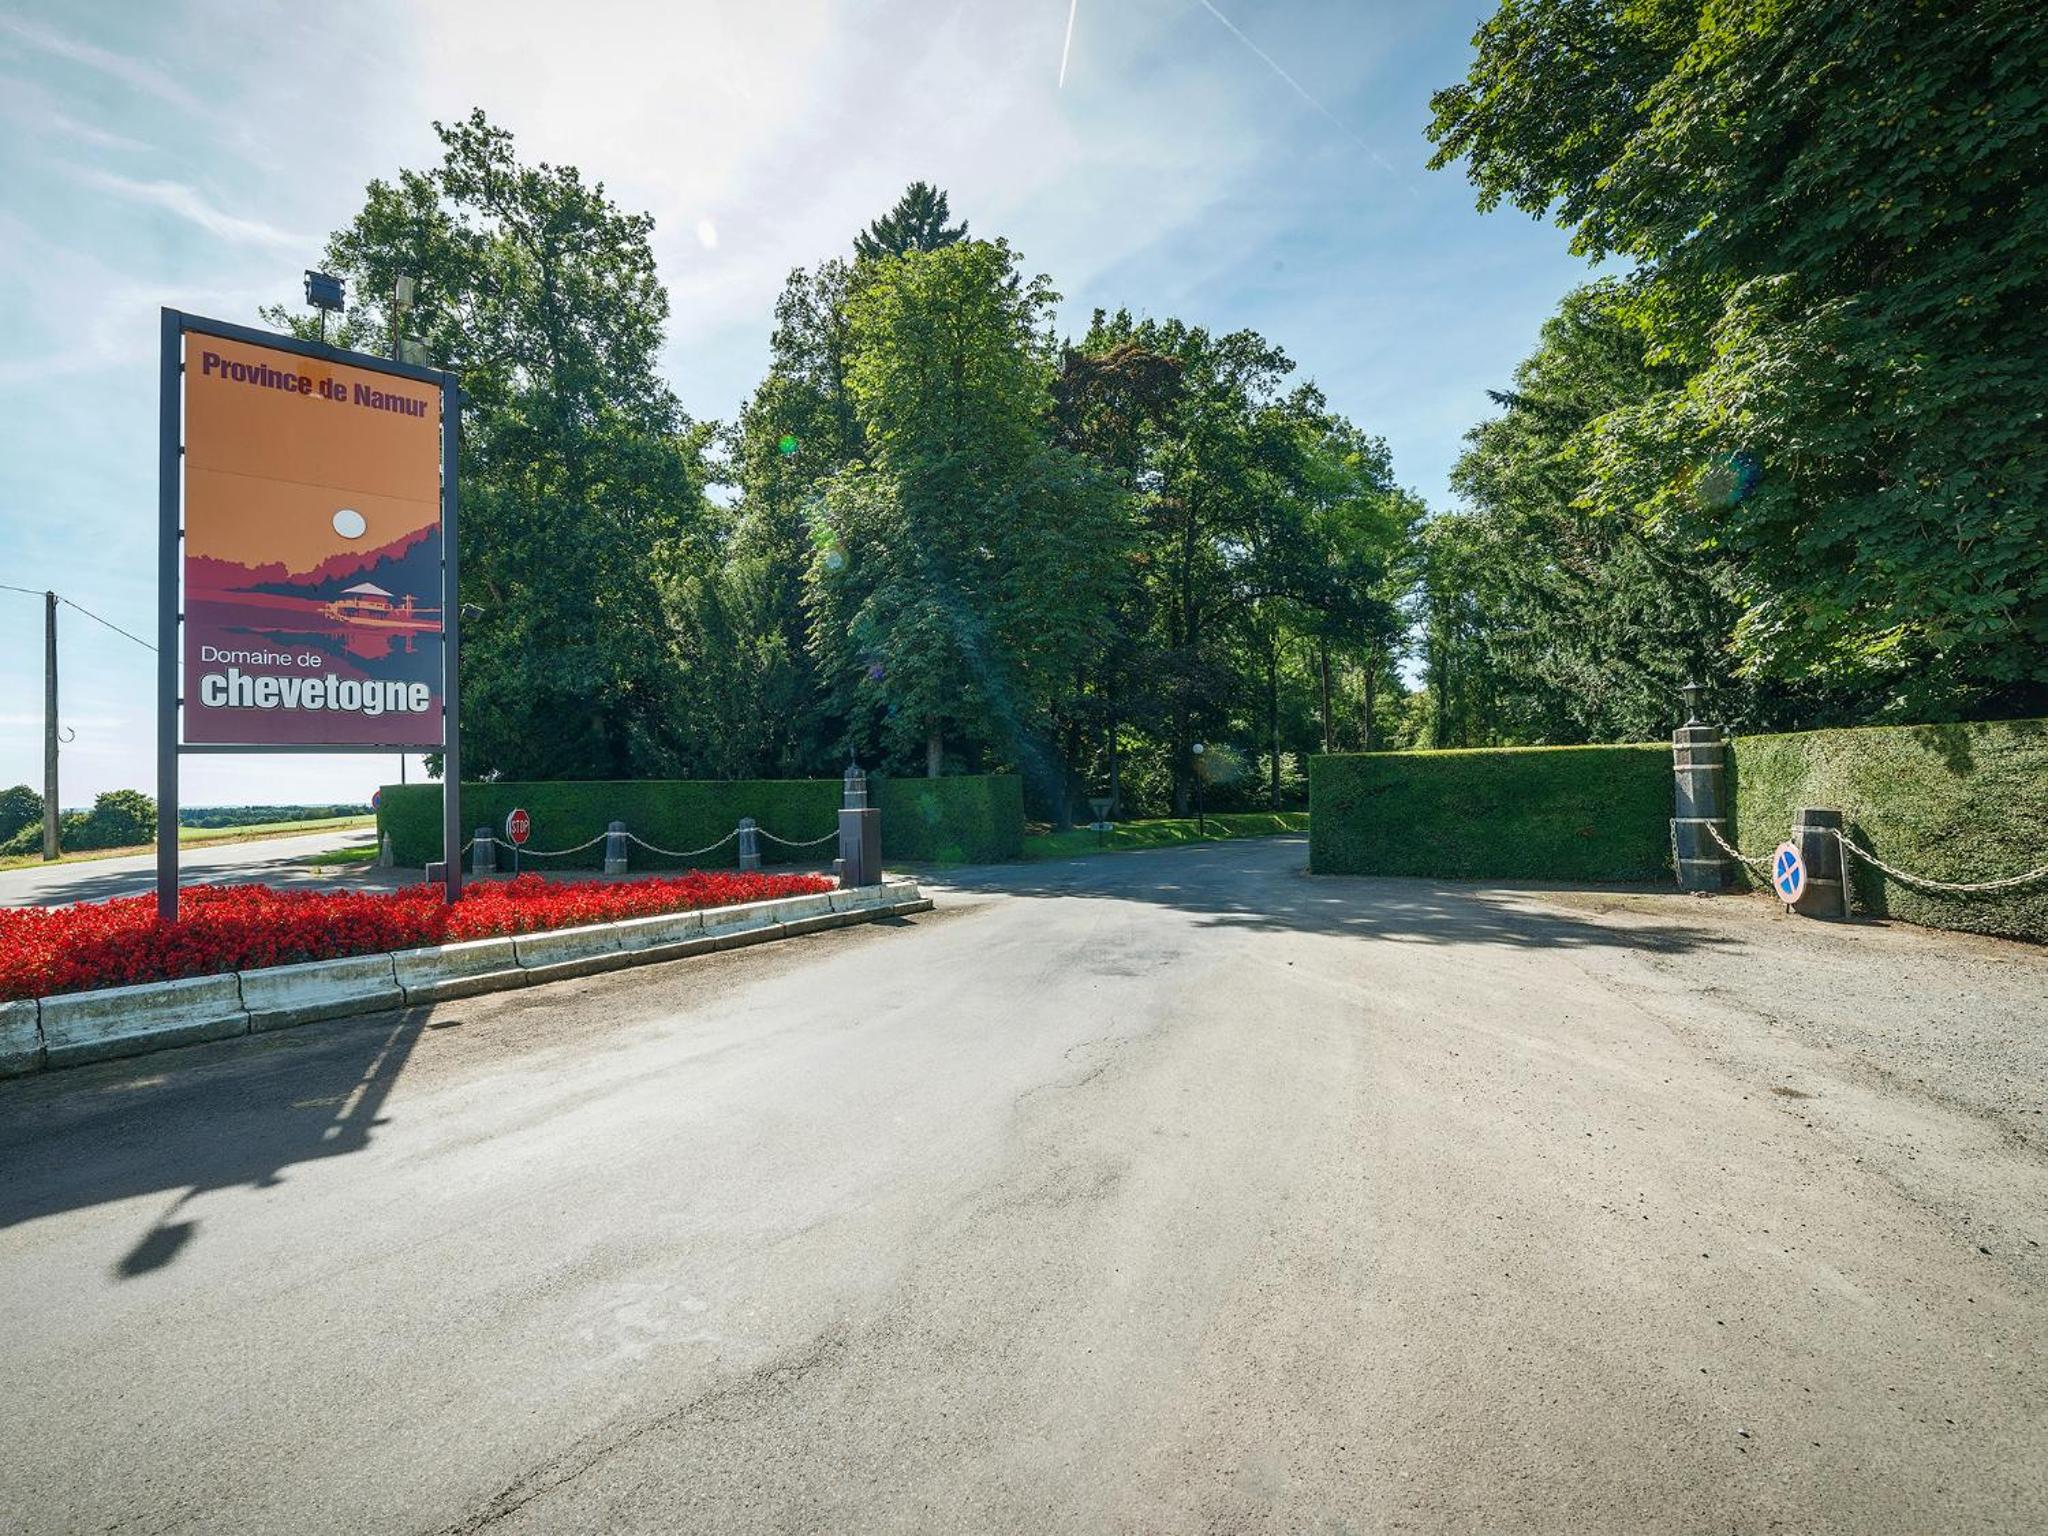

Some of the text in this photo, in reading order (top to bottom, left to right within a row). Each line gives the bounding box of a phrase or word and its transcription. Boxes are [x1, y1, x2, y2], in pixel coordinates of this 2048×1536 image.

[202, 351, 428, 418] Province de Namur
[201, 646, 322, 667] Domaine de
[201, 667, 430, 715] chevetogne
[512, 820, 528, 833] STOP
